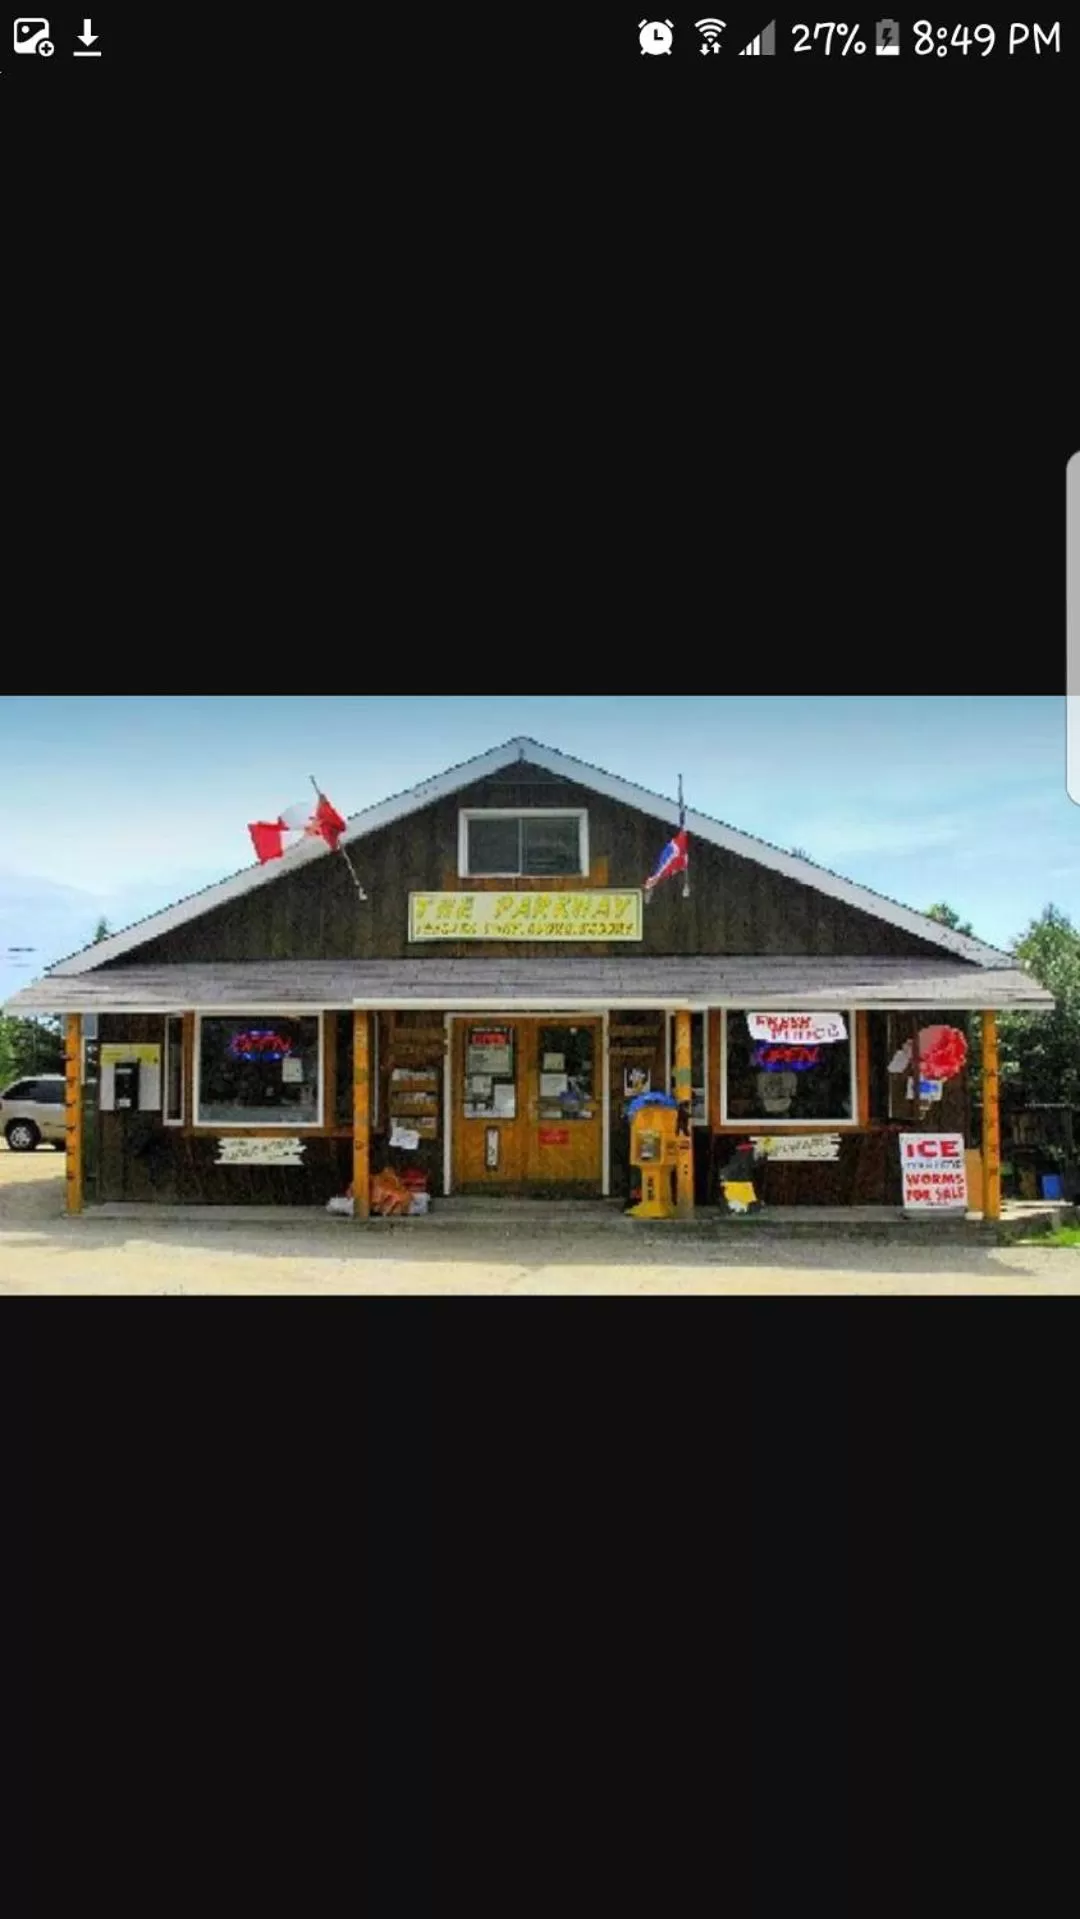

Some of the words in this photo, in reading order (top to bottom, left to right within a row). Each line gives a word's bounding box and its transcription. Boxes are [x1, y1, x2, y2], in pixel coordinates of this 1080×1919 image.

[416, 896, 475, 919] THE
[494, 894, 632, 919] PARKWAY
[906, 1140, 959, 1158] ICE
[906, 1173, 964, 1186] WORMS
[907, 1189, 930, 1201] FOR
[934, 1187, 965, 1203] SALE
